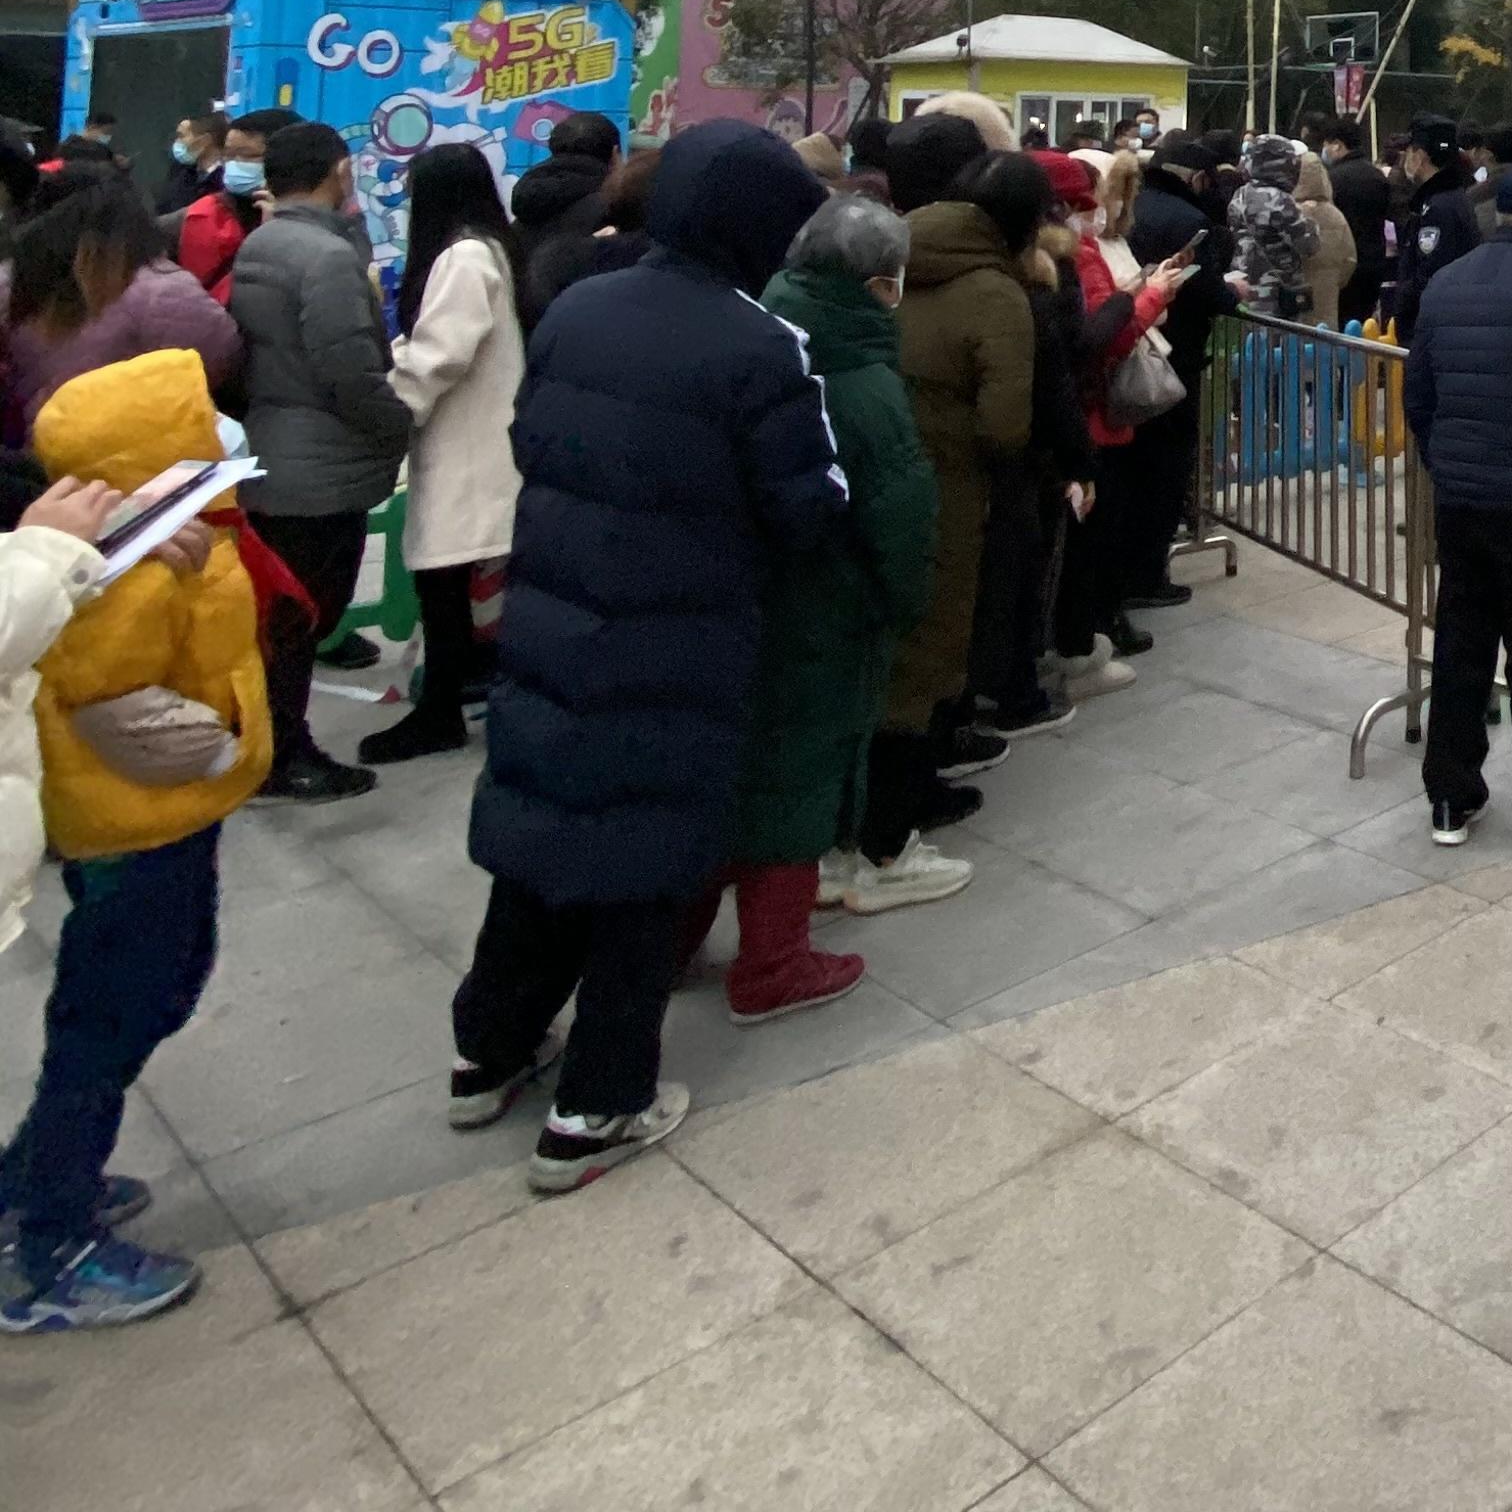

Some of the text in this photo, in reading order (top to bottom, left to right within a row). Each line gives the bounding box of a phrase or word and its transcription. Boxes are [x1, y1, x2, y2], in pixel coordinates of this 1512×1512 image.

[507, 6, 586, 60] 5G
[481, 44, 616, 104] 潮我看
